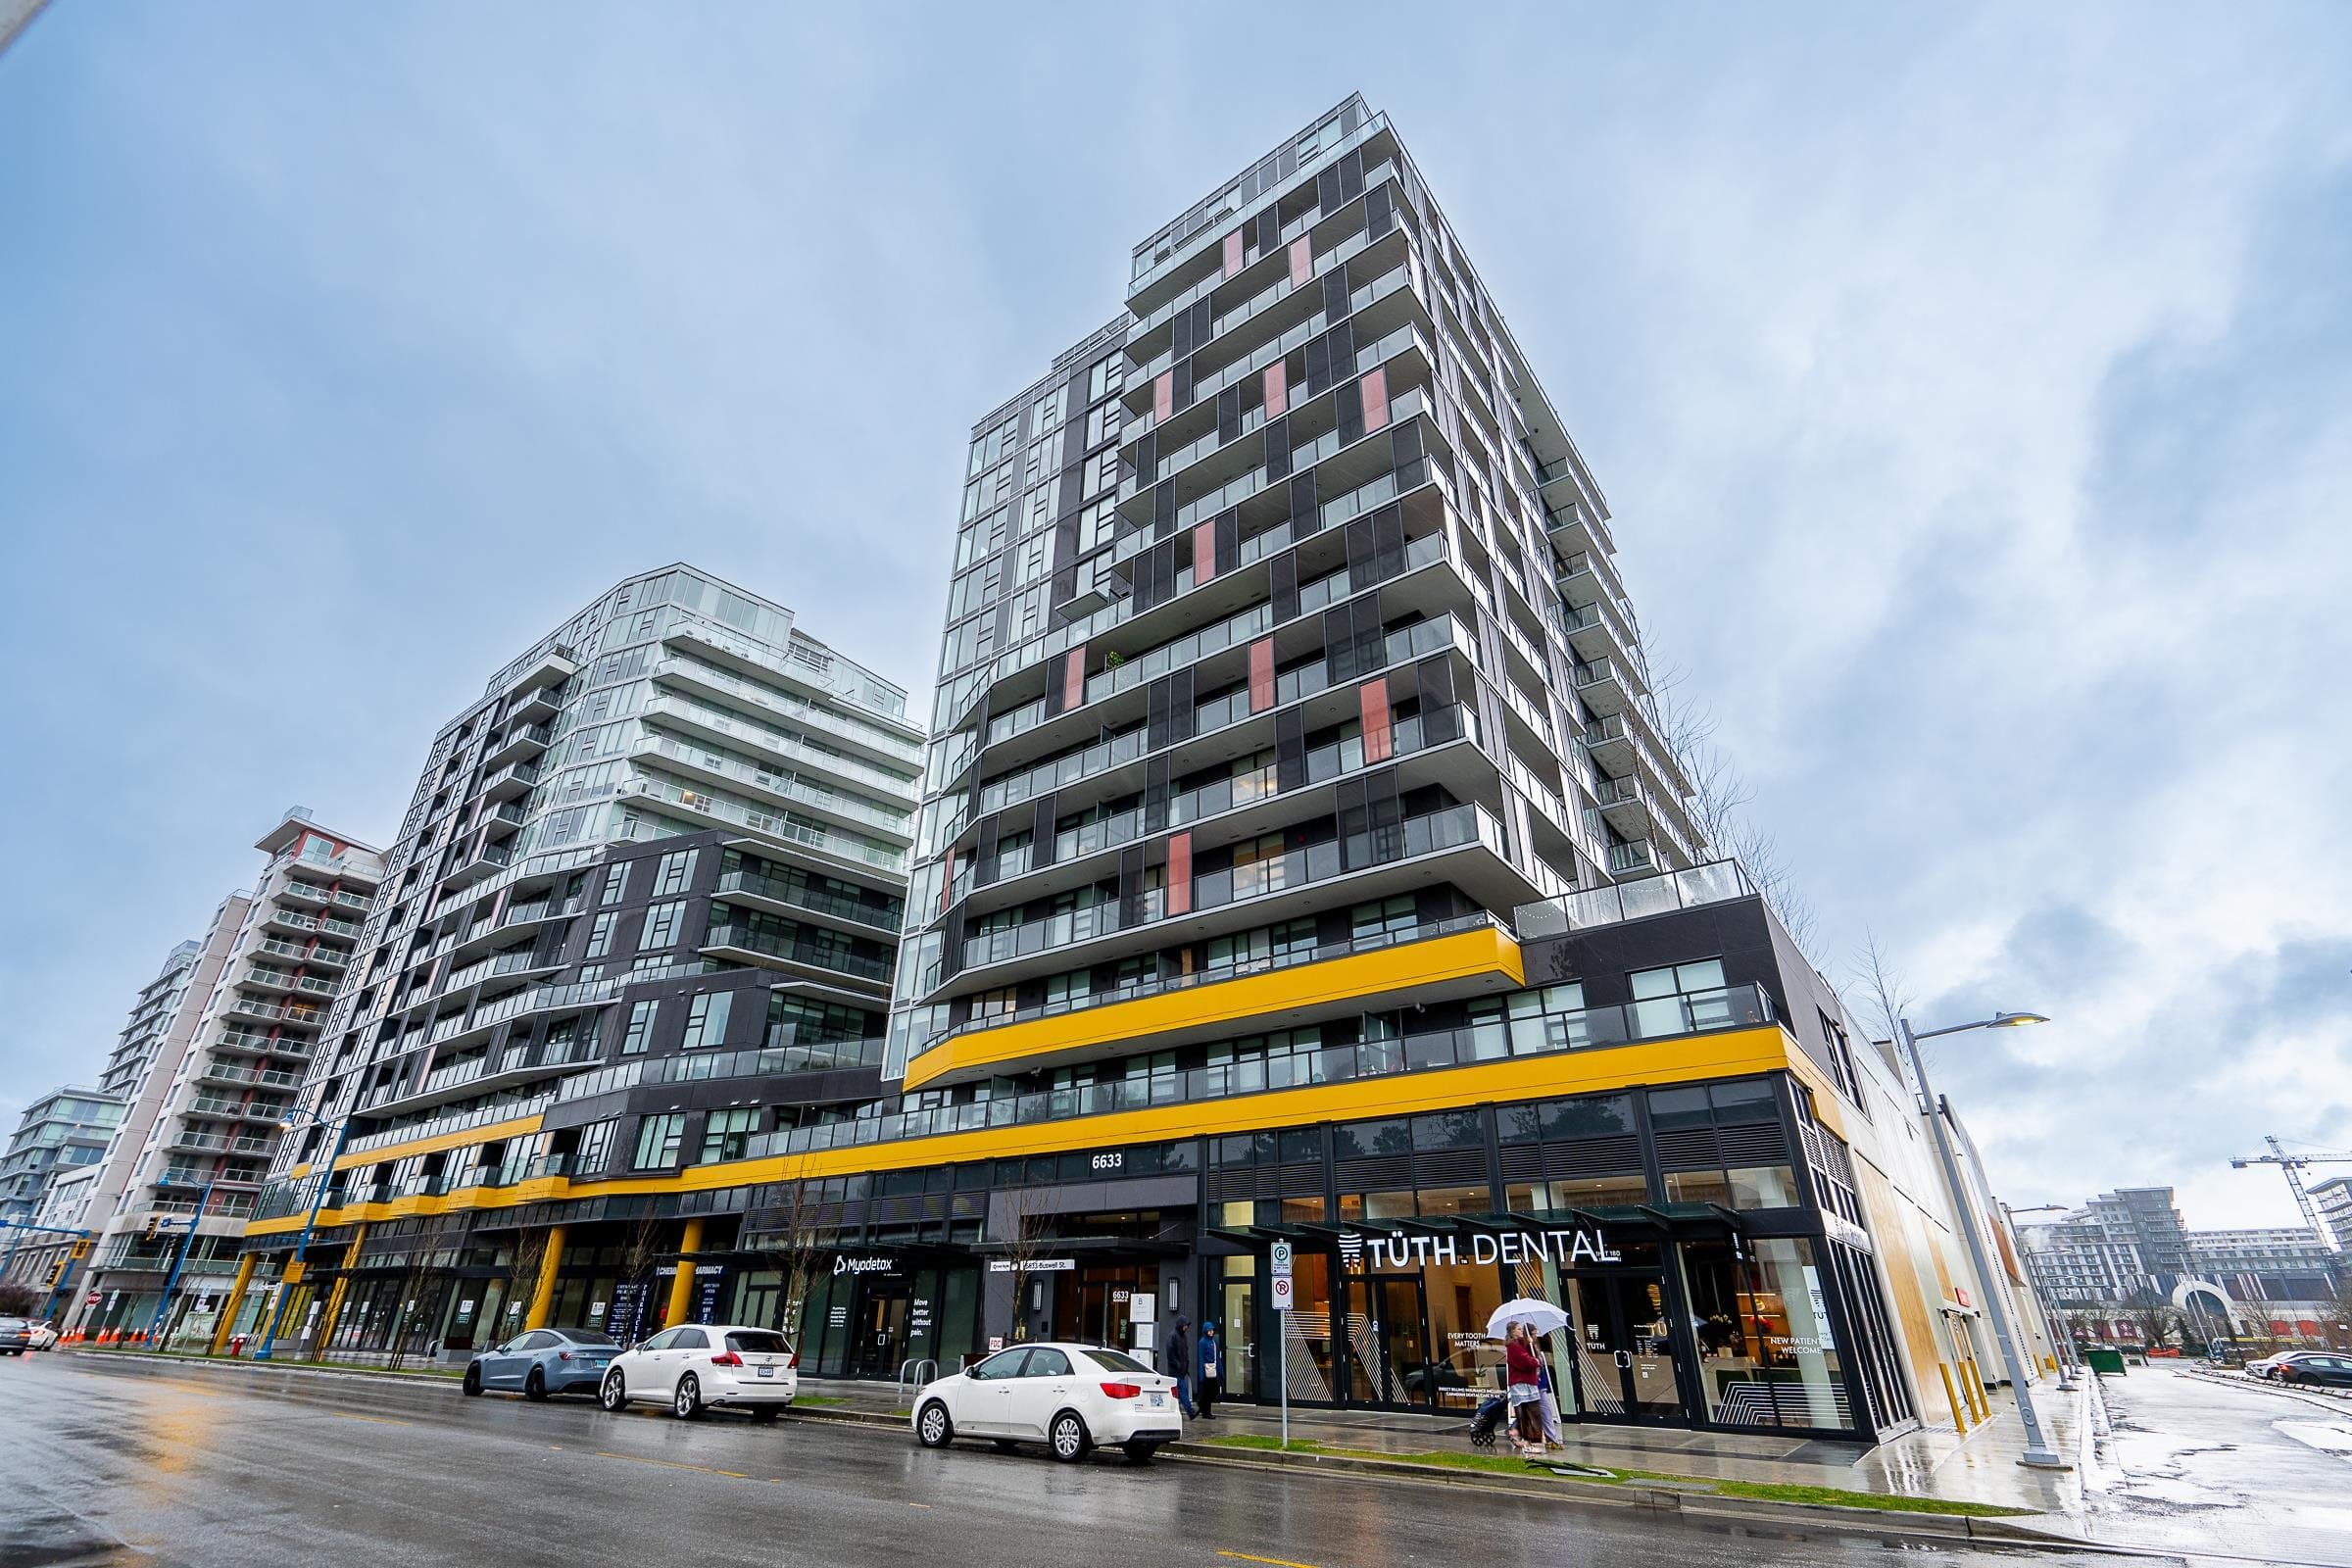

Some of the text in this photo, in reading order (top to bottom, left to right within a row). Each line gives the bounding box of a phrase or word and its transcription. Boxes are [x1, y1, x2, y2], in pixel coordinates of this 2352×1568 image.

[1092, 1152, 1122, 1169] 6633
[1366, 1231, 1456, 1268] TÜTH
[1473, 1229, 1619, 1265] DENTAL
[847, 1256, 893, 1275] Myodetox
[1112, 1291, 1129, 1299] 6633
[913, 1298, 928, 1306] Move
[912, 1307, 929, 1316] better
[911, 1317, 931, 1326] without
[991, 1340, 1002, 1348] FDC
[1781, 1346, 1823, 1354] WELCOME
